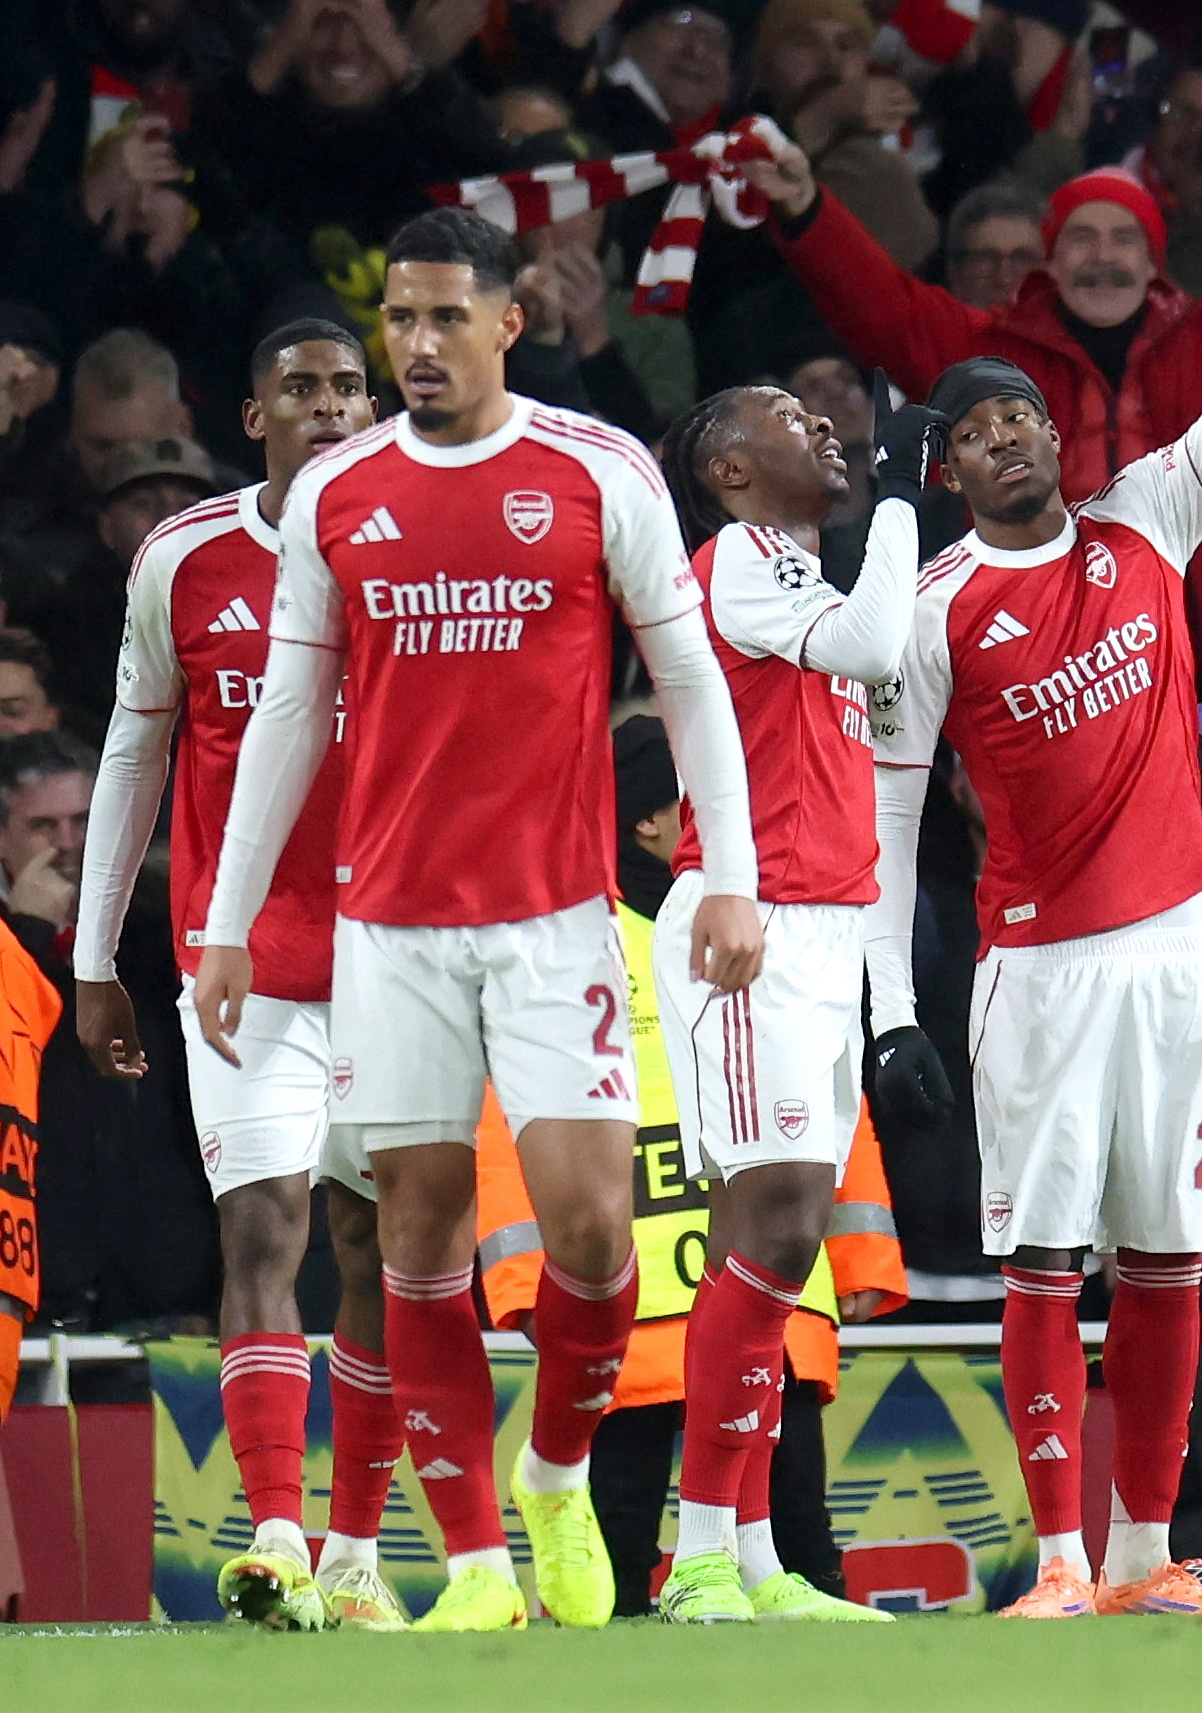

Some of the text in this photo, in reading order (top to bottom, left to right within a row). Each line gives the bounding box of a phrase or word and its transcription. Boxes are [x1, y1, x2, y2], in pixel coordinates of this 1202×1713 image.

[361, 570, 554, 620] Emirates
[393, 617, 524, 656] FLY BETTER
[1001, 613, 1157, 722] Emirates
[1042, 657, 1153, 739] FLY BETTER
[584, 984, 624, 1057] 2
